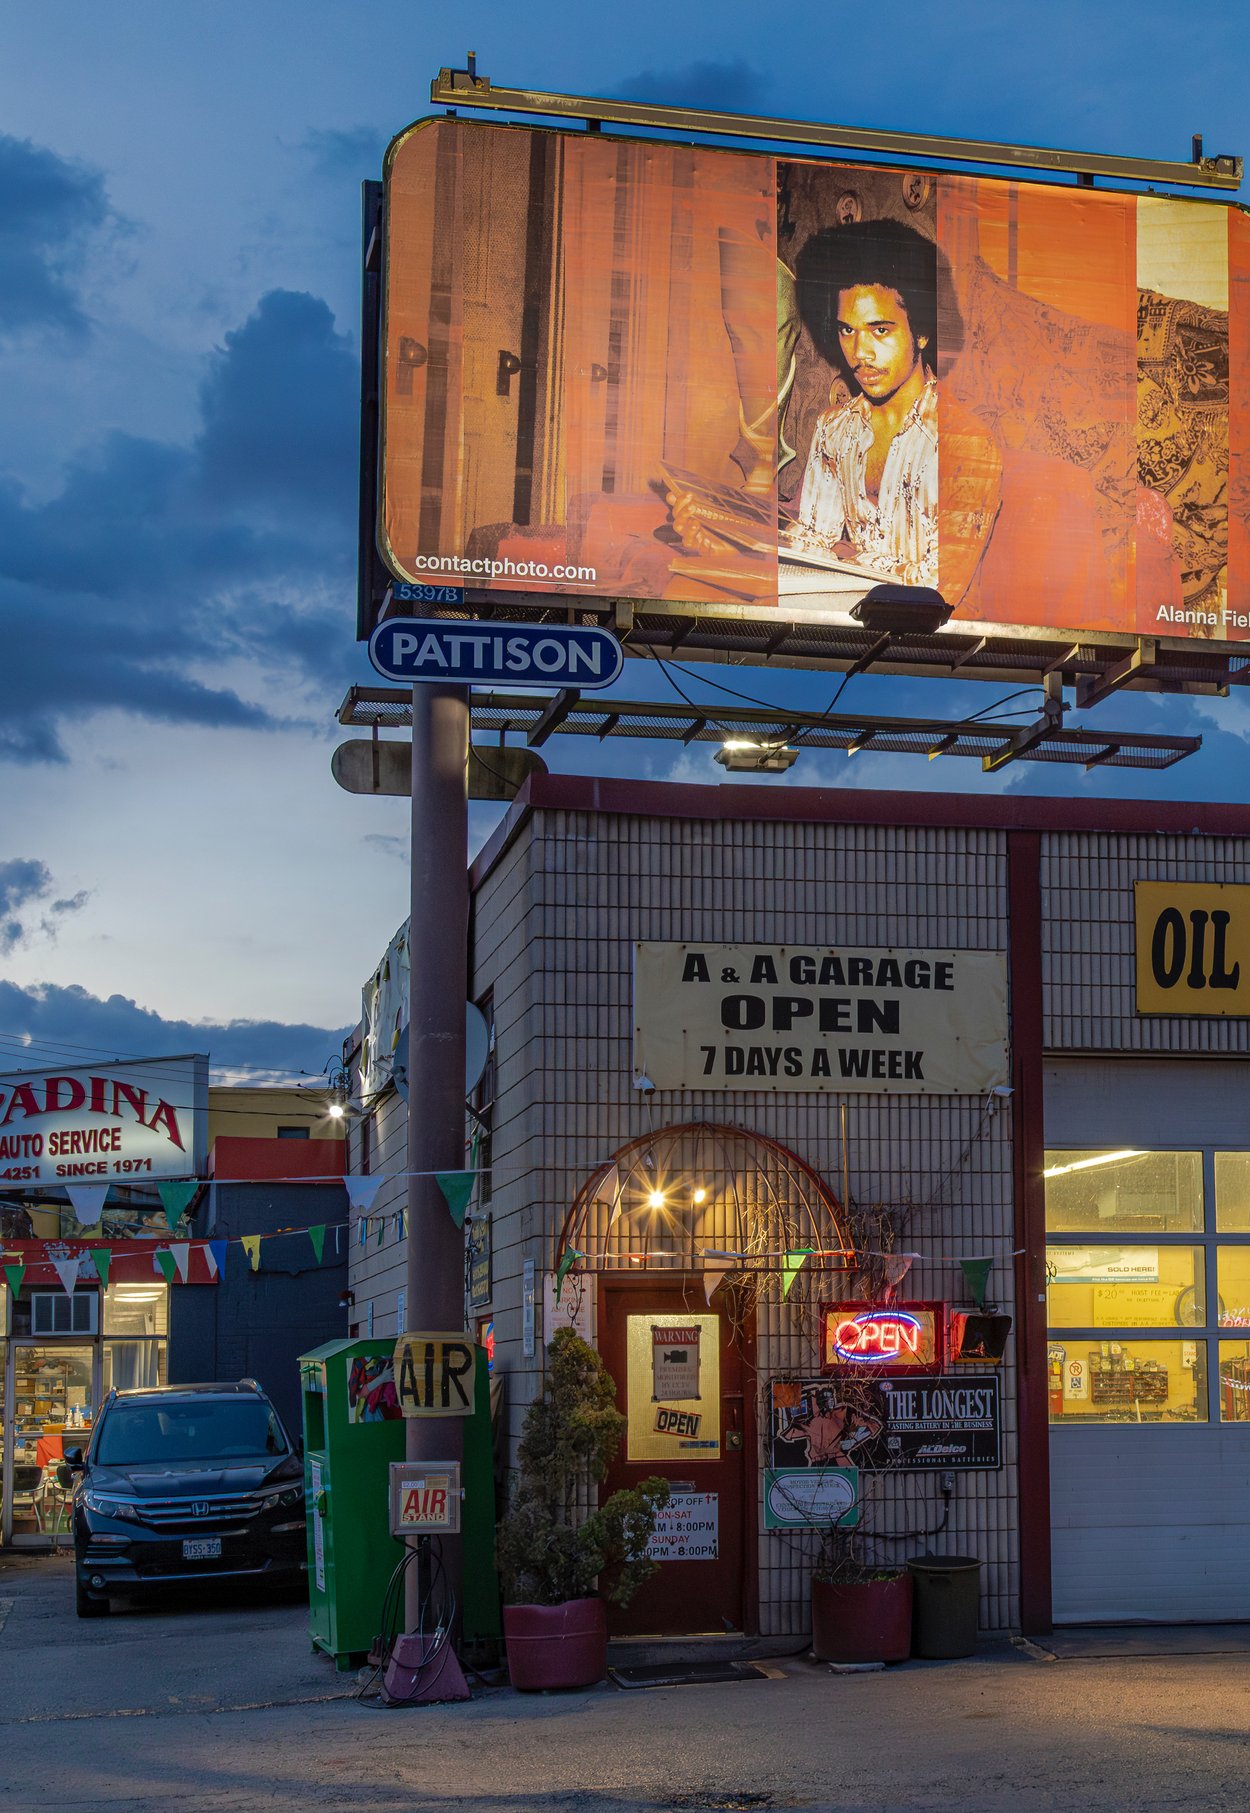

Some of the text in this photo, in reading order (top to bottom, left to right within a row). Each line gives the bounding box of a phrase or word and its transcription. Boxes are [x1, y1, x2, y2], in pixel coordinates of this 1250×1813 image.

[415, 554, 597, 581] contactphoto.com
[399, 584, 458, 602] 5397B
[1156, 605, 1217, 625] Alanna
[392, 632, 601, 675] PATTISON
[1151, 906, 1240, 991] OIL
[681, 953, 955, 991] A & A GARAGE
[720, 994, 900, 1034] OPEN
[700, 1045, 925, 1080] 7 DAYS A WEEK
[0, 1076, 187, 1153] ADINA
[0, 1127, 122, 1160] AUTO SERVICE
[56, 1161, 108, 1177] SINCE
[113, 1158, 152, 1173] 1971
[654, 1330, 698, 1342] WARNING
[835, 1320, 919, 1352] OPEN
[400, 1342, 473, 1408] AIR
[886, 1389, 994, 1420] THE LONGEST
[657, 1410, 699, 1436] OPEN
[887, 1422, 914, 1430] LASTING
[915, 1421, 941, 1430] BATTERY
[942, 1421, 950, 1429] IN
[964, 1420, 993, 1429] BUSINESS
[403, 1489, 447, 1514] AIR
[686, 1498, 703, 1506] OFF
[402, 1513, 445, 1522] STAND
[654, 1511, 692, 1520] ON-SAT
[676, 1522, 715, 1532] 8:00PM
[651, 1535, 690, 1544] SUNDAY
[678, 1546, 717, 1556] 8:00PM
